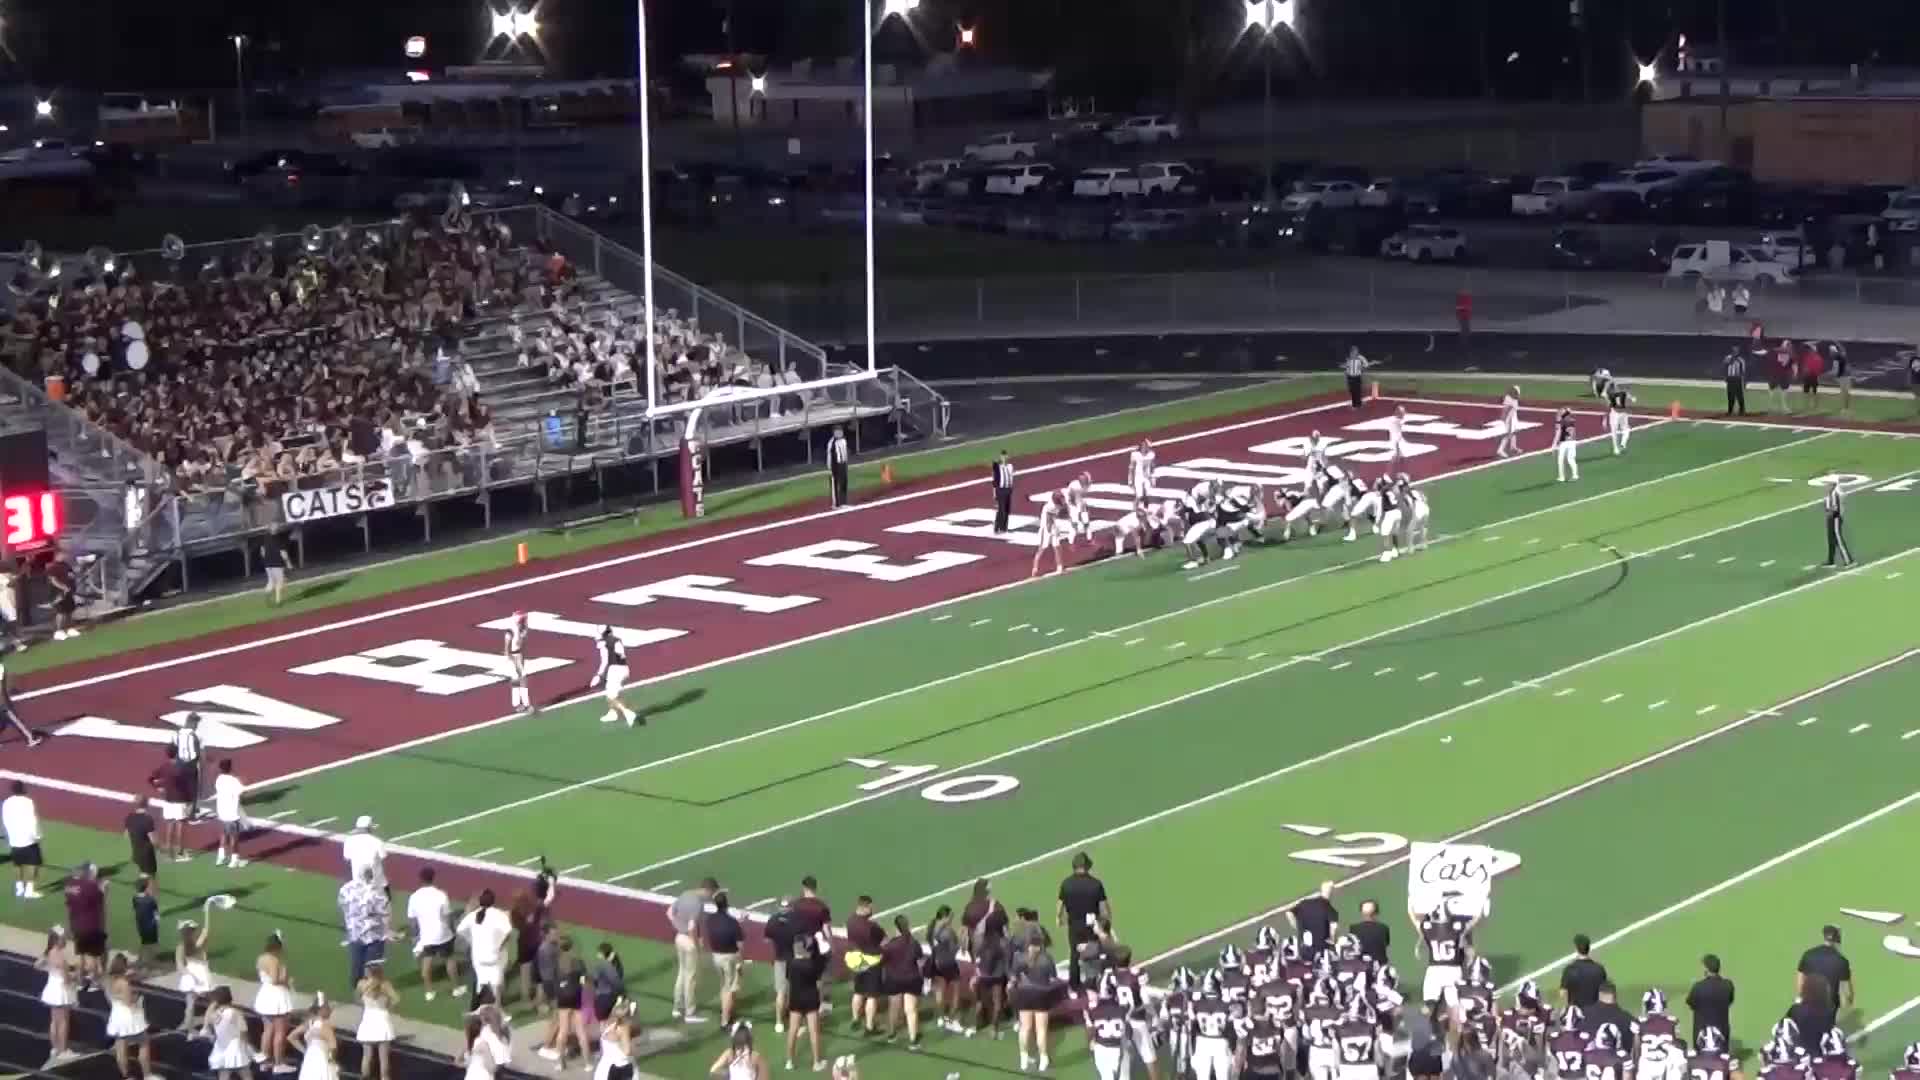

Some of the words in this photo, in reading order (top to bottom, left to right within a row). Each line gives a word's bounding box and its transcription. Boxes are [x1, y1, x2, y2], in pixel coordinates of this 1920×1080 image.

[5, 492, 56, 544] 31
[286, 483, 363, 519] CATS
[857, 764, 1020, 802] 10
[1430, 940, 1456, 961] 16
